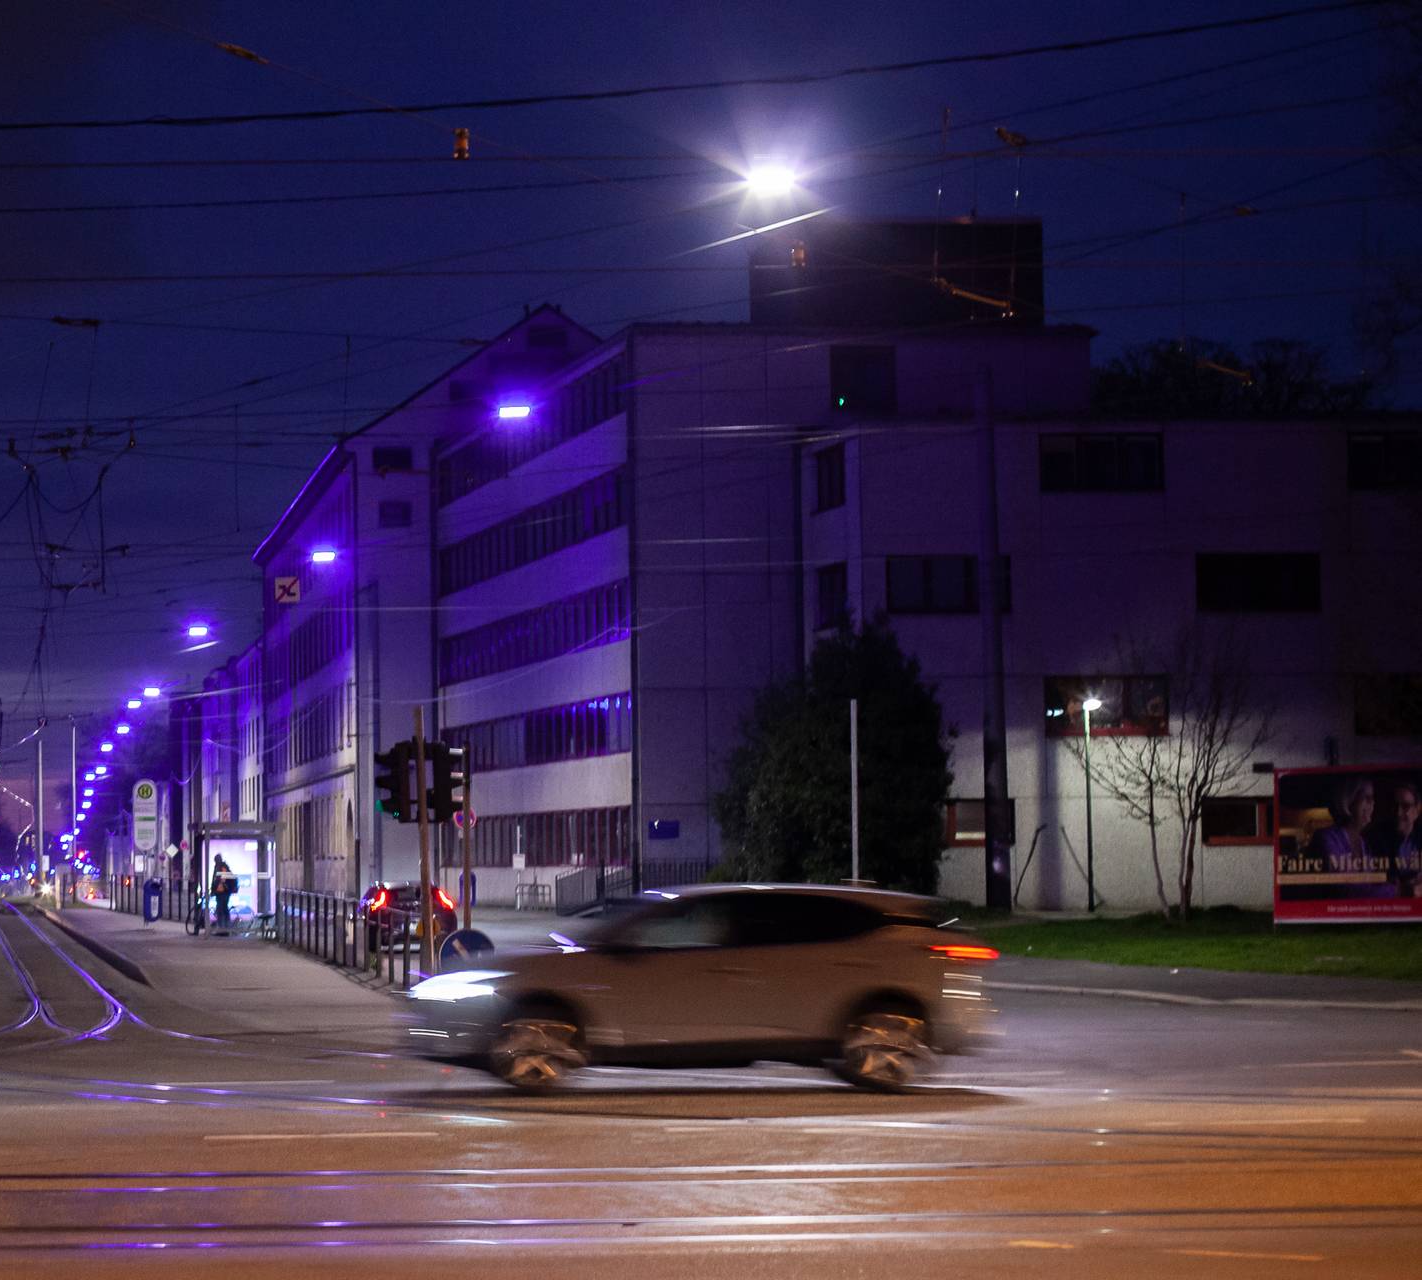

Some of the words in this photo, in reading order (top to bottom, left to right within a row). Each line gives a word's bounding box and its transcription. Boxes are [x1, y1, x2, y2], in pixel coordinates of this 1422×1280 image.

[1277, 853, 1323, 872] Faire
[1328, 853, 1390, 871] Mieten
[1393, 849, 1422, 870] wä
